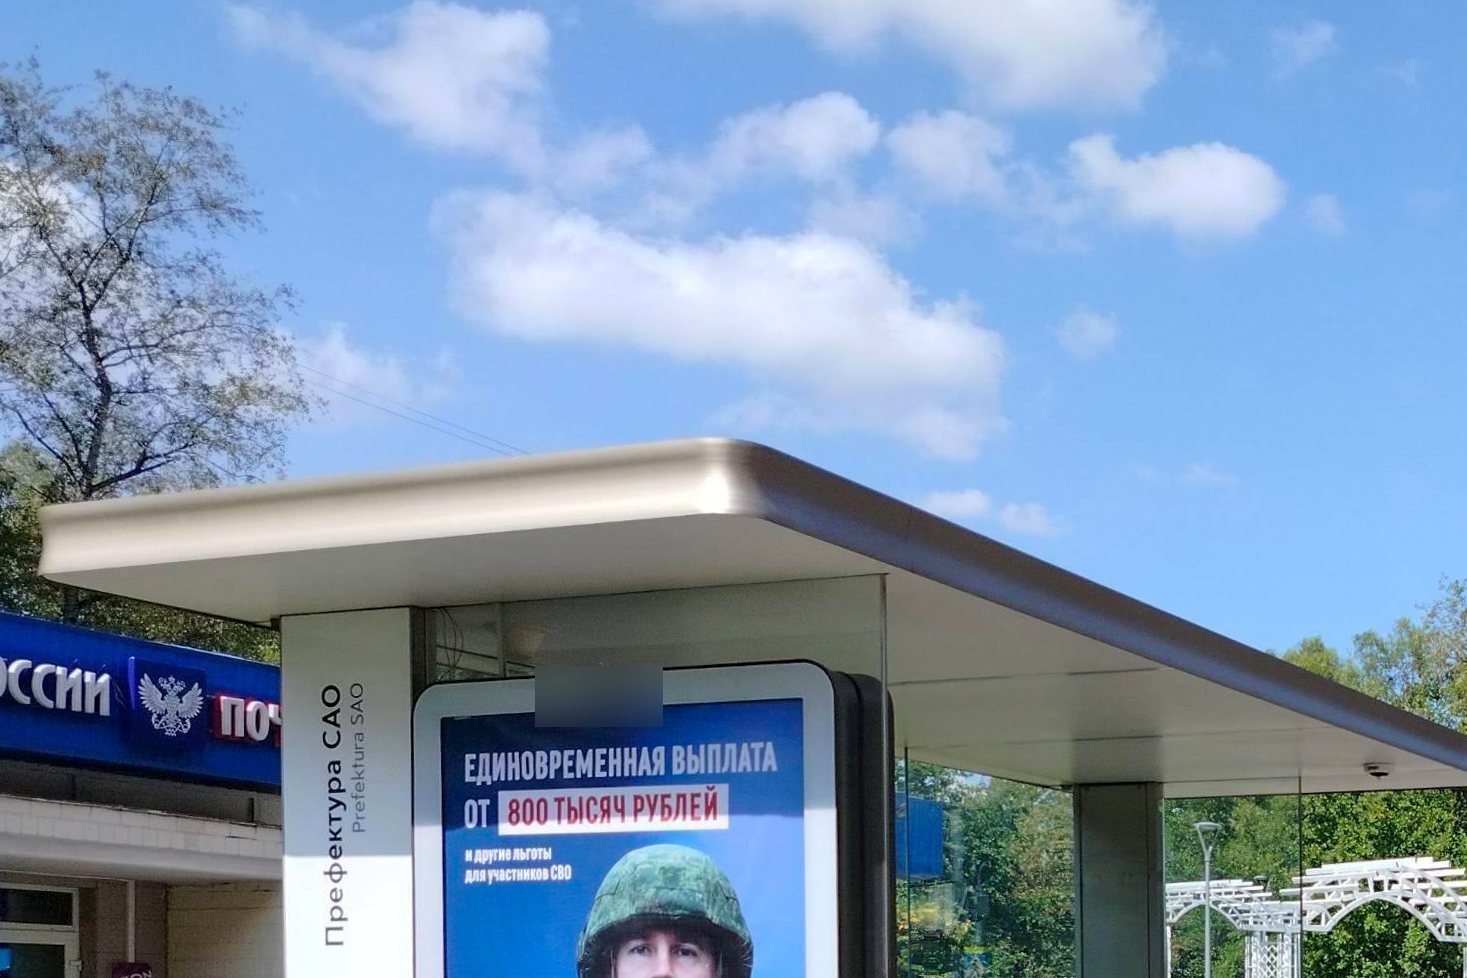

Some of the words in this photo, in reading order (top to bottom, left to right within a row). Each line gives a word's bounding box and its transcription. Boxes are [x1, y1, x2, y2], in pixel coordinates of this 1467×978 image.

[321, 684, 341, 749] САО
[349, 682, 364, 726] SAO
[350, 732, 366, 833] Prefektura
[464, 745, 665, 786] ЕДИНОВРЕМЕННАЯ
[671, 741, 778, 776] ВЫПЛАТА
[464, 798, 490, 829] ОТ
[508, 798, 549, 826] 800
[554, 794, 626, 825] ТЫСЯЧ
[633, 785, 718, 823] РУБЛЕЙ
[323, 760, 348, 946] Префектура
[464, 869, 487, 884] для
[487, 867, 549, 886] участников
[550, 864, 573, 881] СВО
[465, 849, 473, 862] и
[474, 848, 512, 865] другие
[513, 847, 552, 861] льготы
